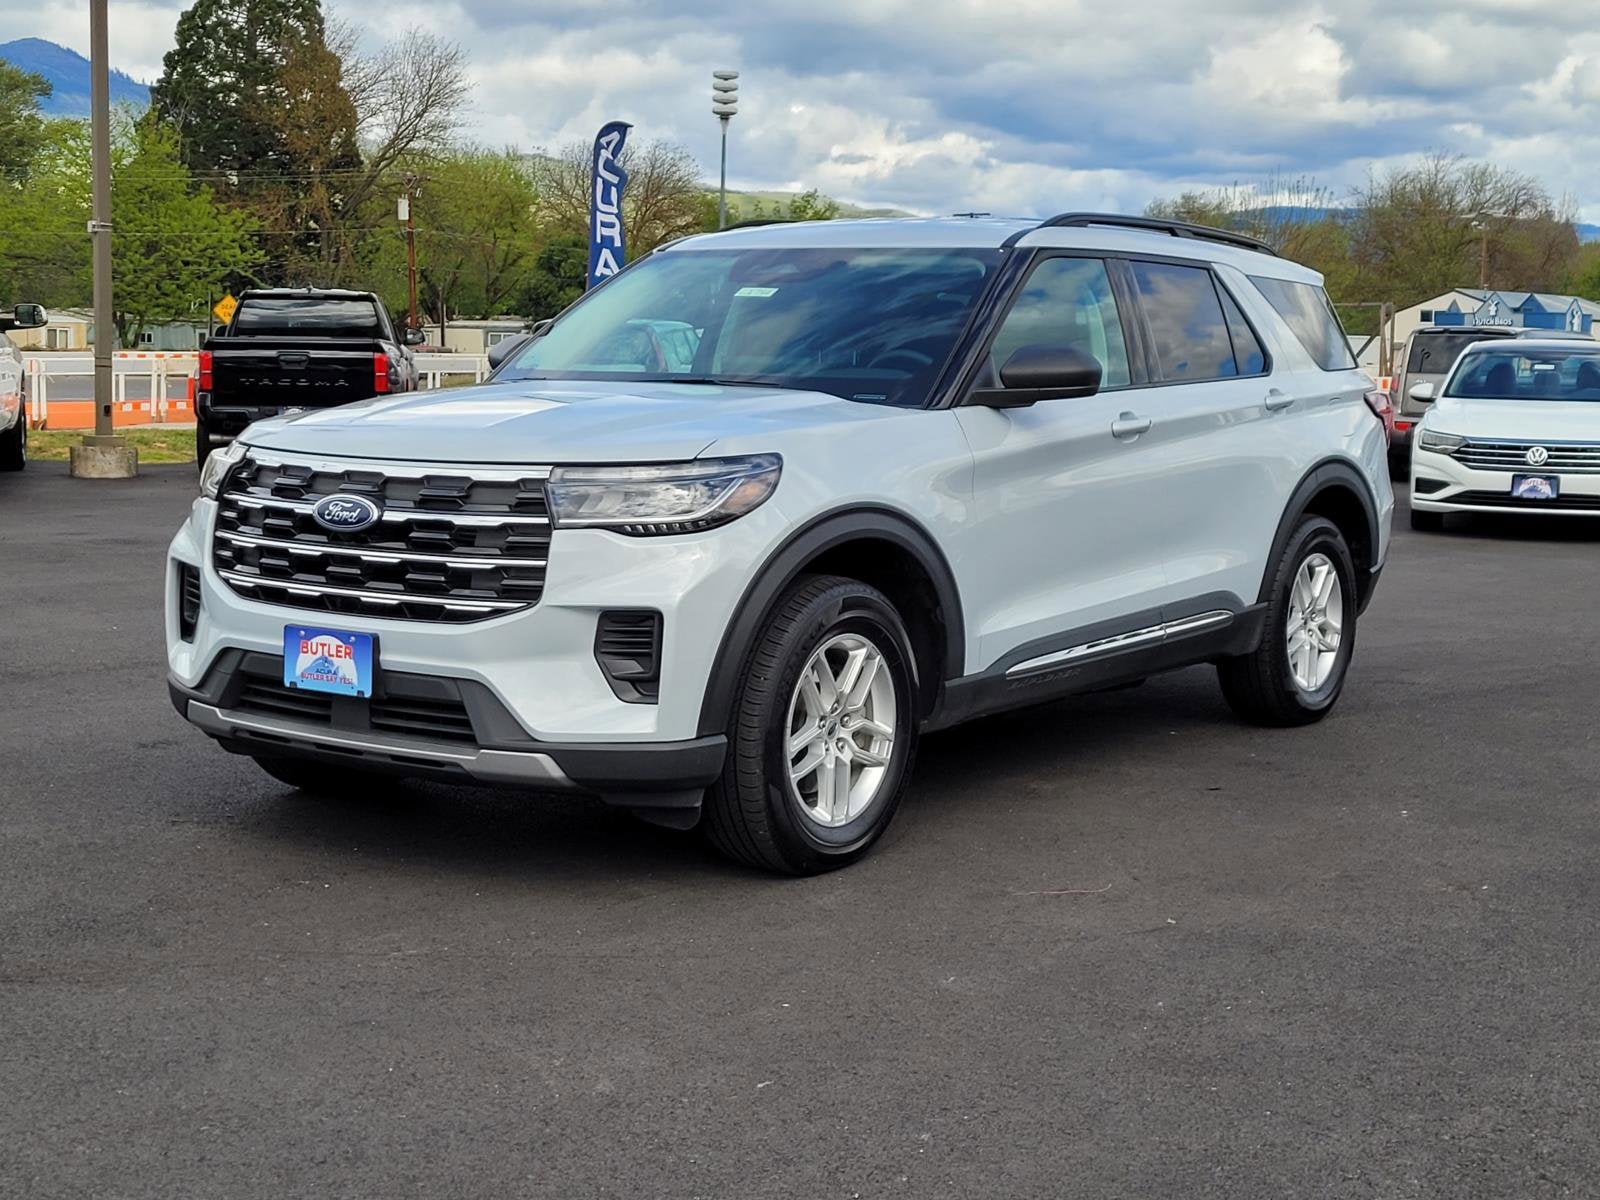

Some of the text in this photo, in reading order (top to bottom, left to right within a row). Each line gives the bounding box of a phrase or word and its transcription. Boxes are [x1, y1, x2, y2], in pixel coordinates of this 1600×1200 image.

[595, 131, 621, 277] ACURA
[240, 378, 349, 386] TACOMA
[324, 501, 361, 523] Ford
[301, 640, 353, 659] BUTLER
